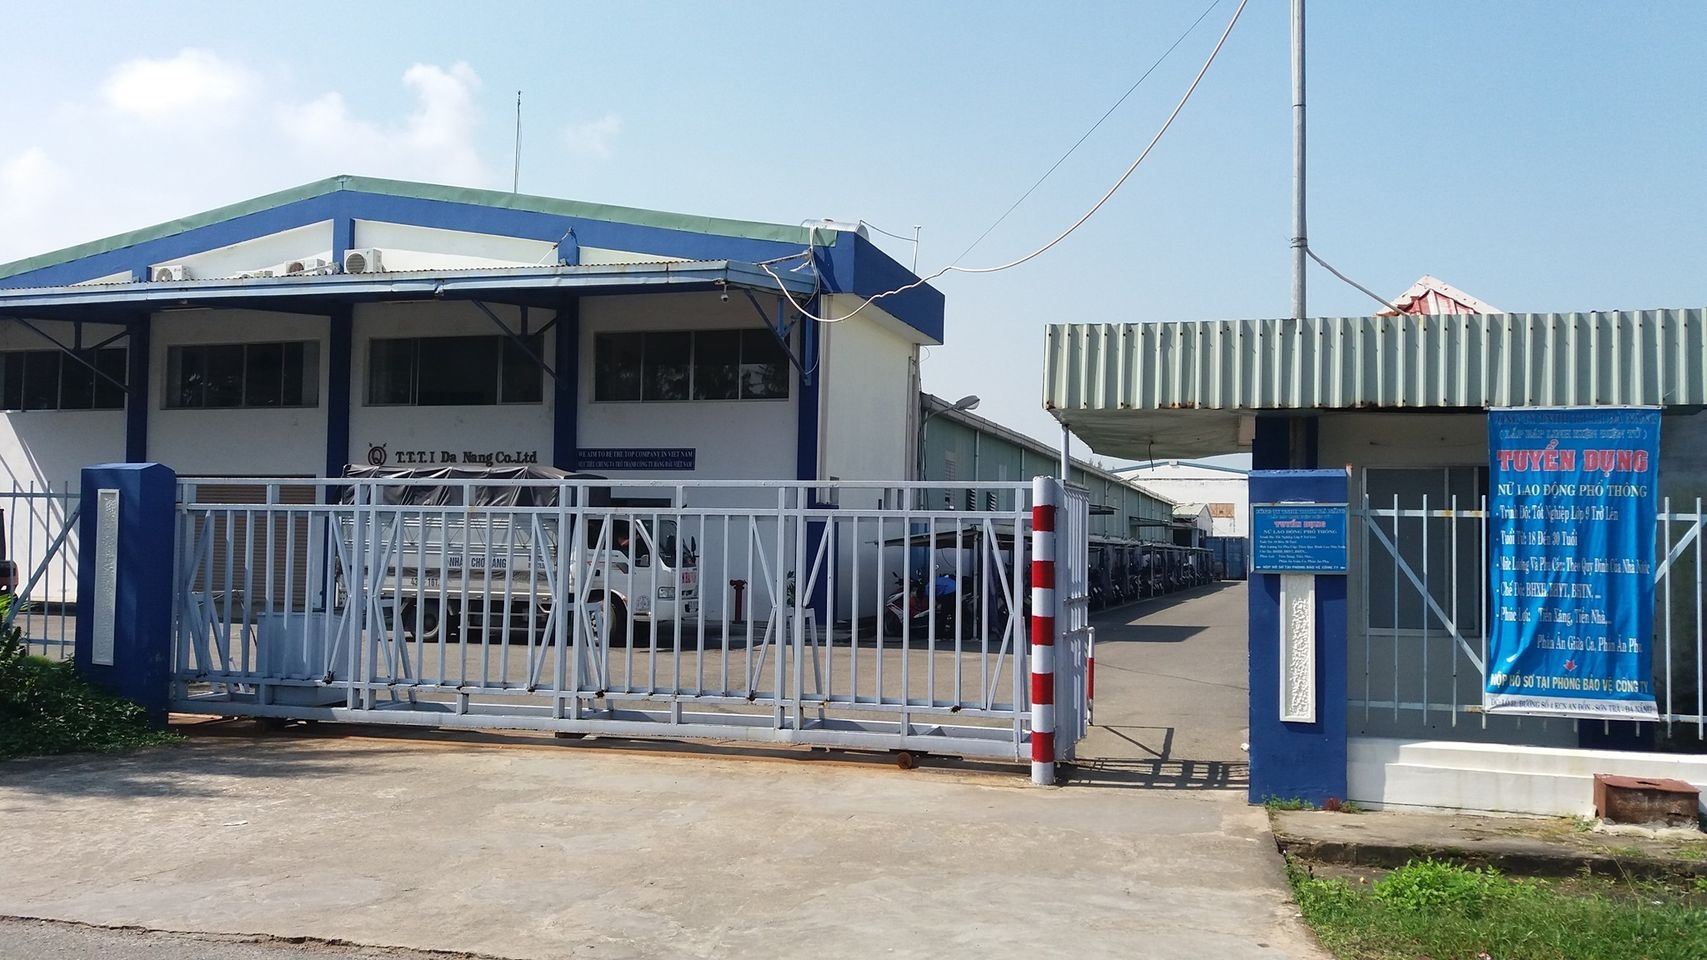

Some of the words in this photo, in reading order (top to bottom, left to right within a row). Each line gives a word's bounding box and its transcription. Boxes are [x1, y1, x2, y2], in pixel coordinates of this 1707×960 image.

[441, 451, 457, 463] Da
[462, 451, 493, 467] Nang
[1497, 439, 1576, 472] TUYỂN
[1583, 449, 1649, 478] DỤNG
[1498, 481, 1514, 496] NỮ
[1517, 484, 1540, 496] LAO
[1543, 481, 1576, 499] ĐỘNG
[1579, 480, 1604, 497] PHỔ
[1607, 482, 1648, 498] THÔNG
[1528, 531, 1537, 545] 18
[1552, 531, 1561, 545] 30
[1561, 529, 1578, 546] Tuổi
[1536, 675, 1550, 692] TẠI
[1552, 673, 1581, 691] PHÒNG
[1582, 674, 1600, 692] BẢO
[1602, 676, 1613, 695] VỆ
[1615, 676, 1639, 693] CÔNG
[1639, 680, 1649, 693] TY
